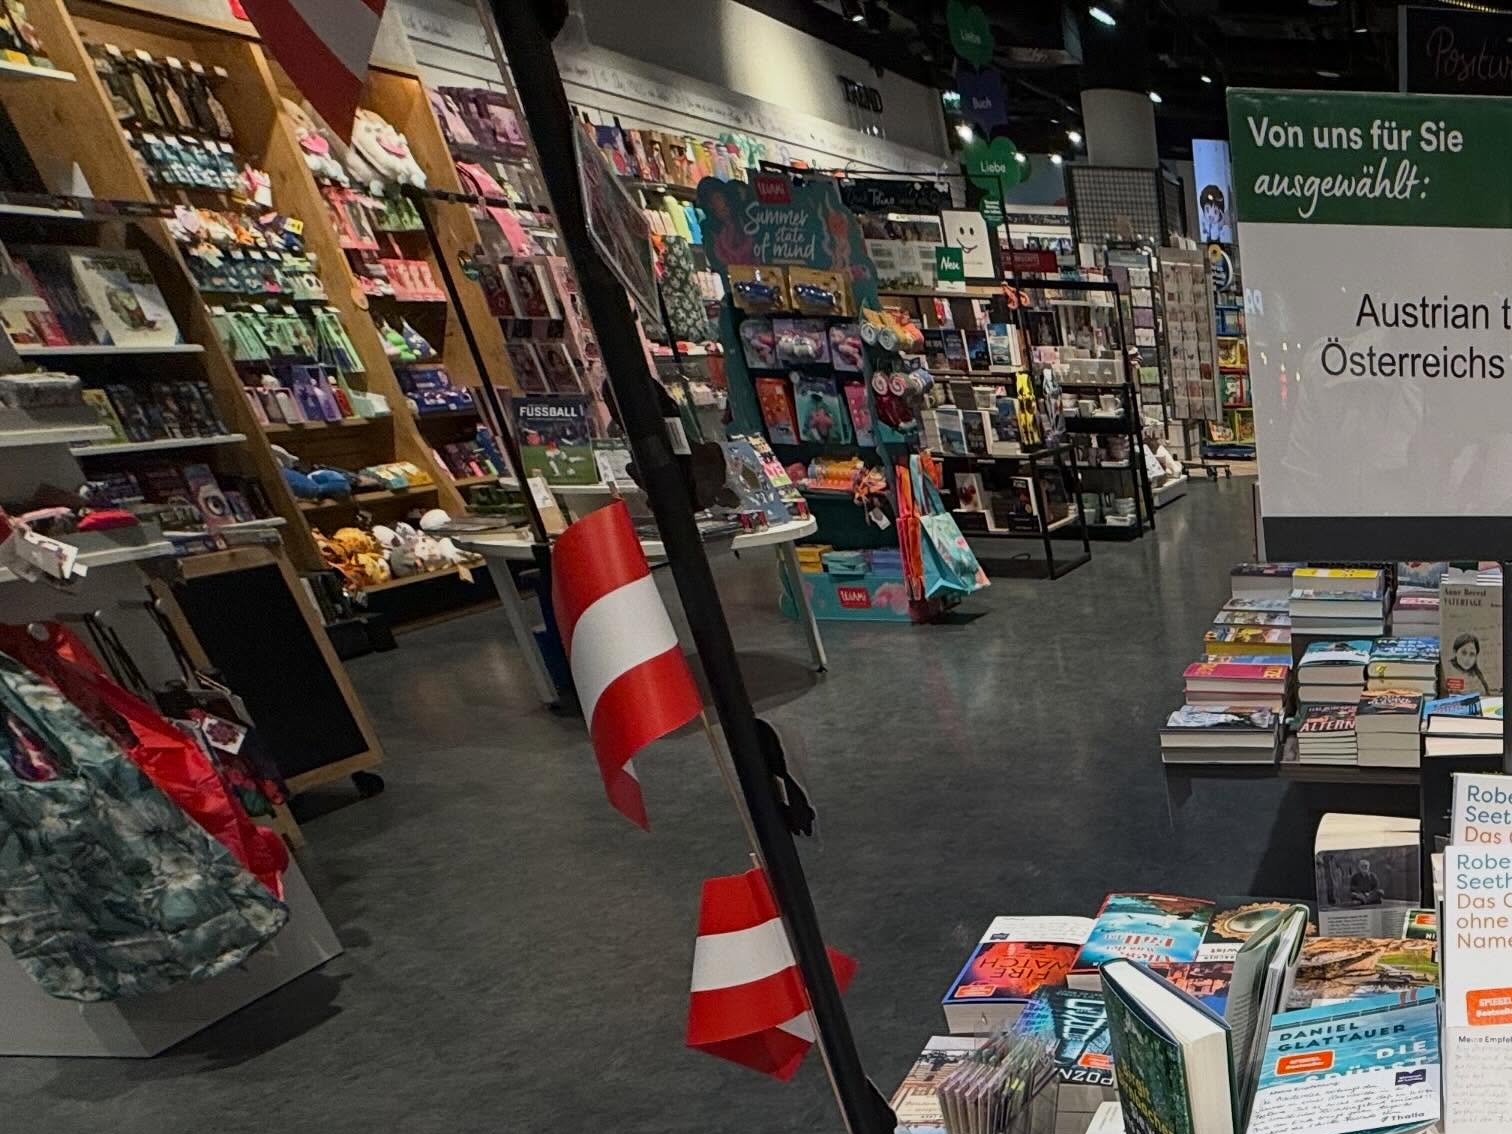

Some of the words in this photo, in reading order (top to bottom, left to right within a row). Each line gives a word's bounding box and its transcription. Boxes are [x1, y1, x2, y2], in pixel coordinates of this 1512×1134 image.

[1247, 117, 1303, 150] Von
[1313, 122, 1363, 151] uns
[1371, 120, 1412, 152] für
[1420, 120, 1464, 153] Sie
[980, 161, 1006, 173] Liebe
[1254, 158, 1431, 219] ausgewählt:
[744, 201, 809, 235] Summer
[775, 226, 806, 242] state
[753, 231, 770, 264] of
[773, 232, 815, 261] mind
[940, 256, 960, 272] Neu
[1355, 293, 1491, 331] Austrian
[1320, 337, 1507, 380] Österreichs
[1464, 826, 1502, 845] Das
[1456, 893, 1497, 910] Das
[1456, 912, 1510, 929] ohne
[990, 968, 1050, 980] FIRE
[1277, 1023, 1408, 1052] GLATTAUER
[1279, 1022, 1360, 1042] DANIEL
[1376, 1040, 1428, 1060] DIE
